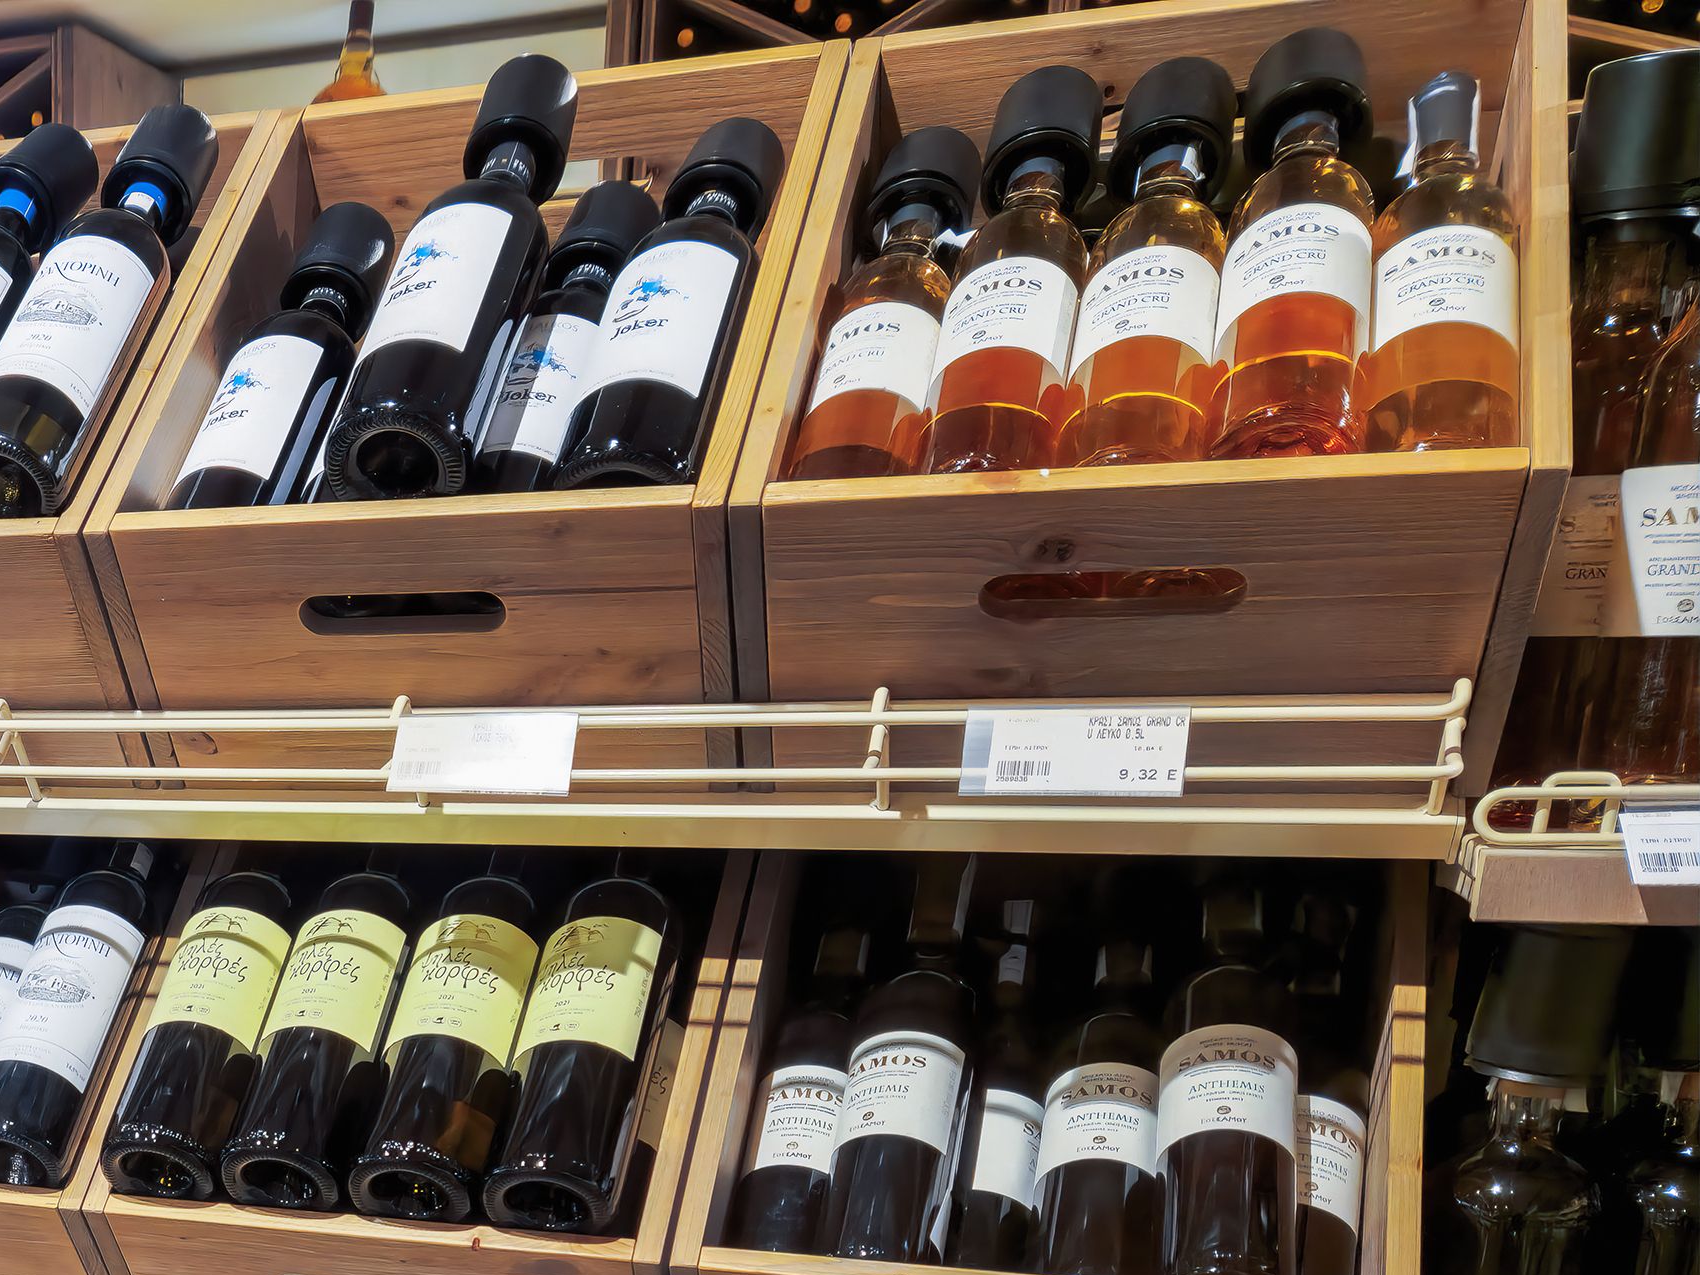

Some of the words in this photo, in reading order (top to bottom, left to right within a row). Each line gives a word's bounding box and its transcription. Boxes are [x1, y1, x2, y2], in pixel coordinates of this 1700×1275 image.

[1243, 254, 1294, 282] GRAND
[1295, 251, 1327, 262] CRU
[1383, 245, 1496, 284] SAMOS
[384, 277, 438, 308] Joker
[1397, 276, 1453, 299] GRAND
[1455, 276, 1486, 287] CRU
[1141, 294, 1171, 304] CRU
[998, 305, 1028, 316] CRU
[609, 316, 669, 342] Joker
[498, 388, 557, 404] Joker
[202, 408, 249, 432] Joker
[1088, 716, 1110, 727] ΚΡΑΣΙ
[1146, 717, 1172, 728] GRAND
[1175, 717, 1186, 727] CR
[1096, 728, 1122, 740] ΛΕΥΚΟ
[1118, 768, 1158, 783] 9,32
[1167, 769, 1178, 781] E
[177, 955, 249, 983] κορφές
[289, 957, 361, 983] κορφές
[422, 963, 500, 994] κορφές
[539, 964, 617, 994] κορφές
[848, 1054, 928, 1080] SAMOS
[1178, 1048, 1277, 1073] SAMOS
[765, 1086, 845, 1108] SAMOS
[847, 1083, 911, 1105] ANTHEMIS
[1060, 1083, 1154, 1105] SAMOS
[1188, 1079, 1267, 1096] ANTHEMIS
[768, 1115, 834, 1131] ANTHEMIS
[1067, 1112, 1141, 1126] ANTHEMIS
